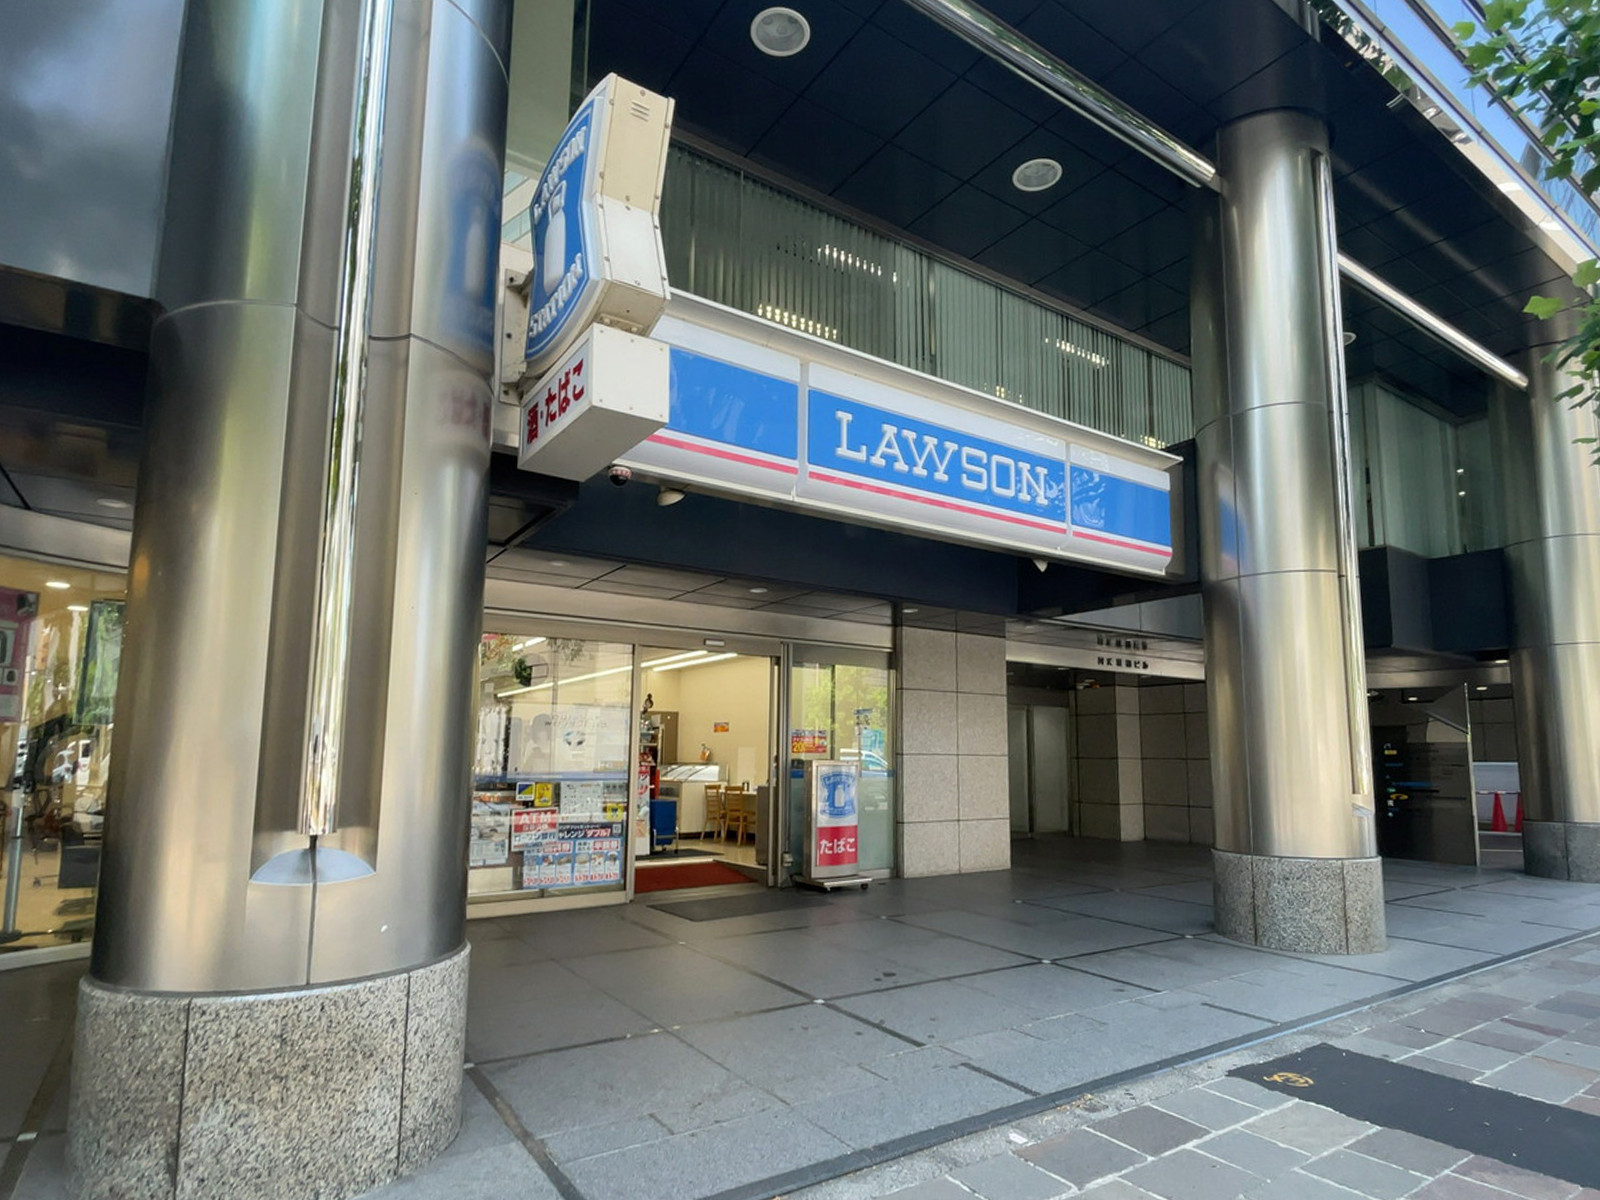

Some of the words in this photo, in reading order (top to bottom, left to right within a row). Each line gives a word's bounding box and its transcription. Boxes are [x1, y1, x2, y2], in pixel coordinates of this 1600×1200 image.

[835, 410, 1048, 506] LAWSON
[519, 812, 553, 825] ATM
[819, 838, 856, 854] たばこ
